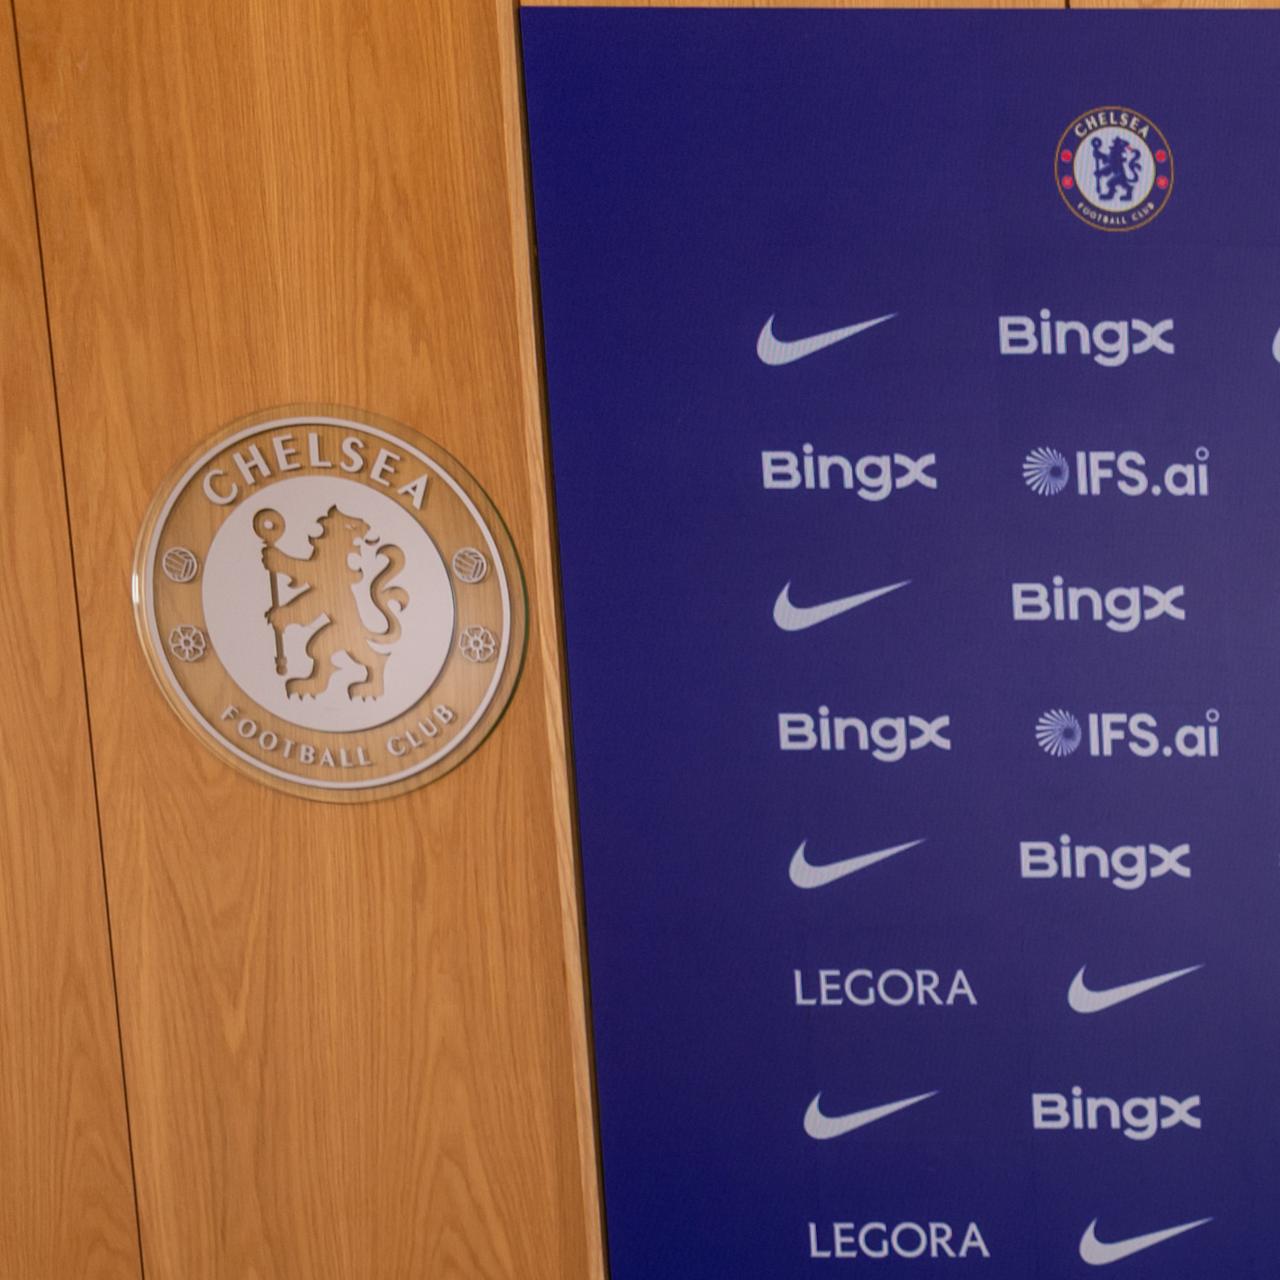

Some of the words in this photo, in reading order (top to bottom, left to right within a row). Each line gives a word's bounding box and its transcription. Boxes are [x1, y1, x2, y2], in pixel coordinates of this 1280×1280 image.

[1074, 111, 1150, 139] CHELSEA
[202, 432, 433, 511] CHELSEA
[1075, 446, 1210, 497] IFS.ai
[221, 704, 373, 768] FOOTBALL
[386, 705, 455, 757] CLUB
[1088, 708, 1220, 758] IFS.ai
[793, 968, 978, 1007] LEGORA
[808, 1221, 991, 1259] LEGORA
